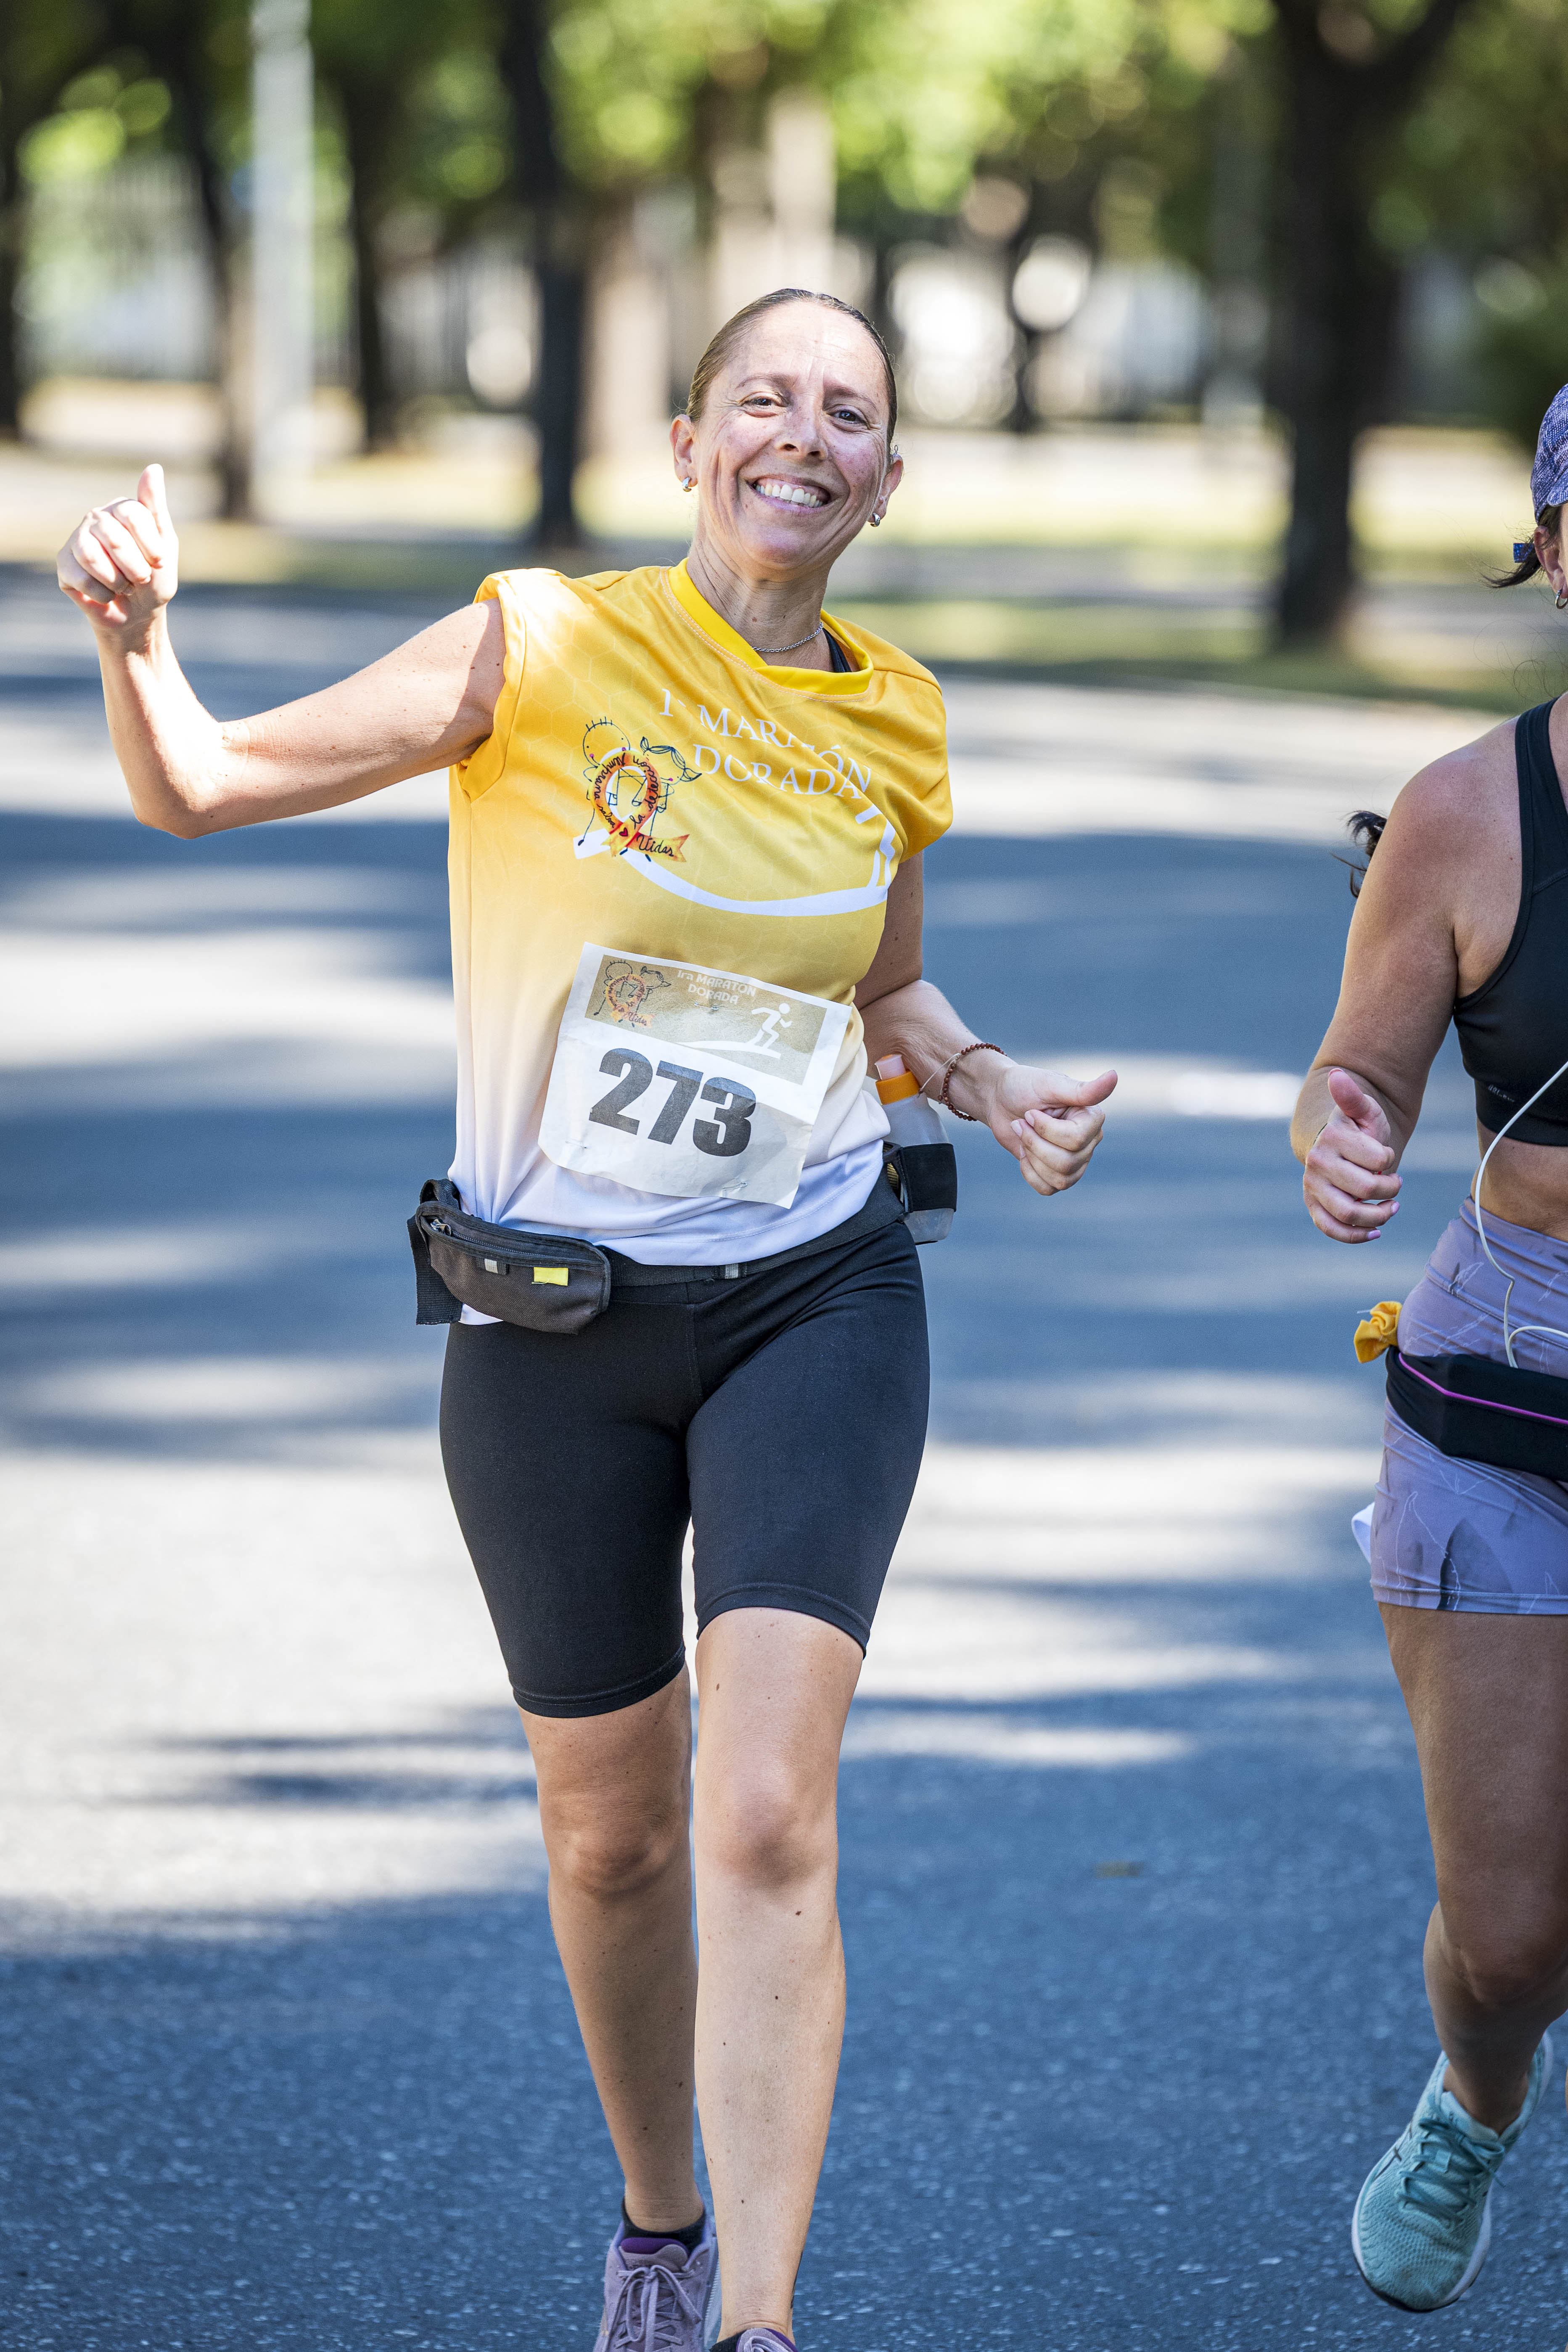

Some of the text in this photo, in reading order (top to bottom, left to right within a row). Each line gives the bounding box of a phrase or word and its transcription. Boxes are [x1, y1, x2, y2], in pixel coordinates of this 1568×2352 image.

[693, 743, 862, 799] DORADA
[596, 804, 616, 828] salva
[629, 814, 645, 830] la
[687, 983, 739, 1005] DORADA
[589, 1048, 756, 1157] 273
